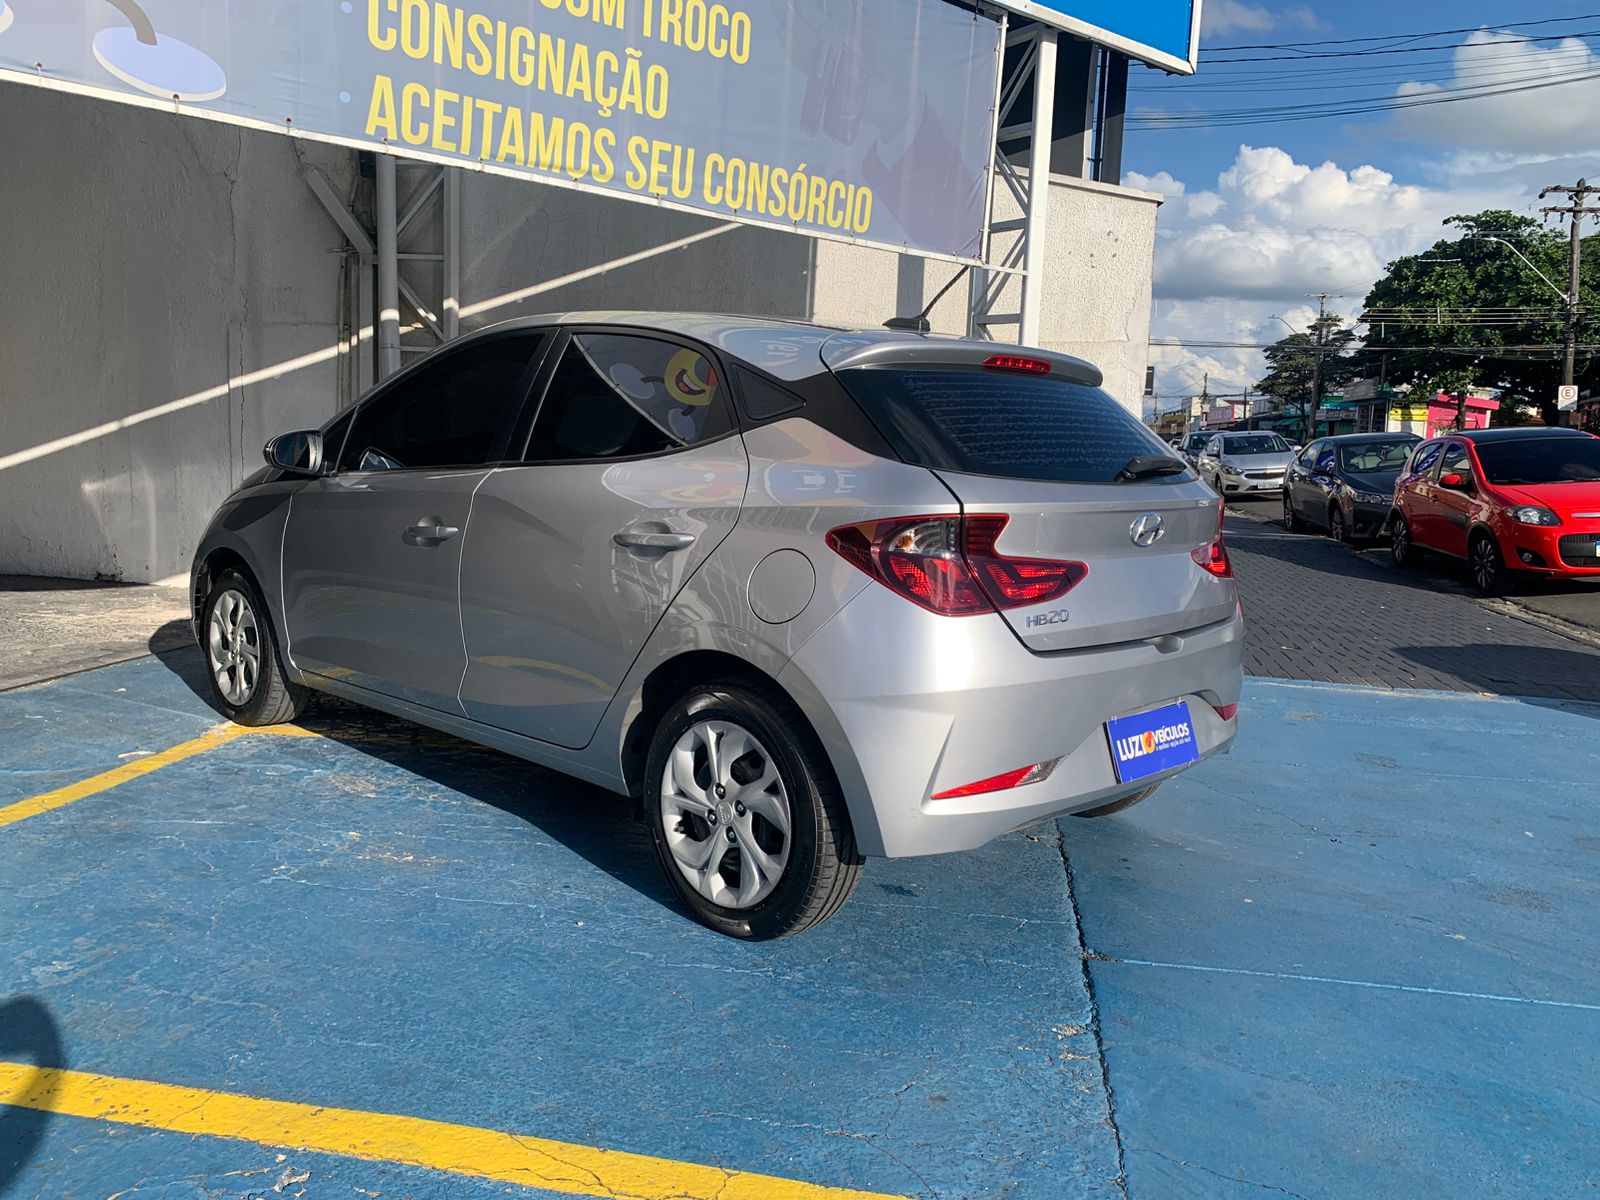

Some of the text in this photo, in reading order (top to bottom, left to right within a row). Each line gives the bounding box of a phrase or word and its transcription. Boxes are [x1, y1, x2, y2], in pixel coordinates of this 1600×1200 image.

[367, 0, 670, 119] CONSIGNAÇÃO
[364, 75, 873, 234] ACEITAMOS SEU CONSÓRCIO
[1025, 609, 1070, 628] HB20
[1152, 722, 1191, 745] VEÍCULOS
